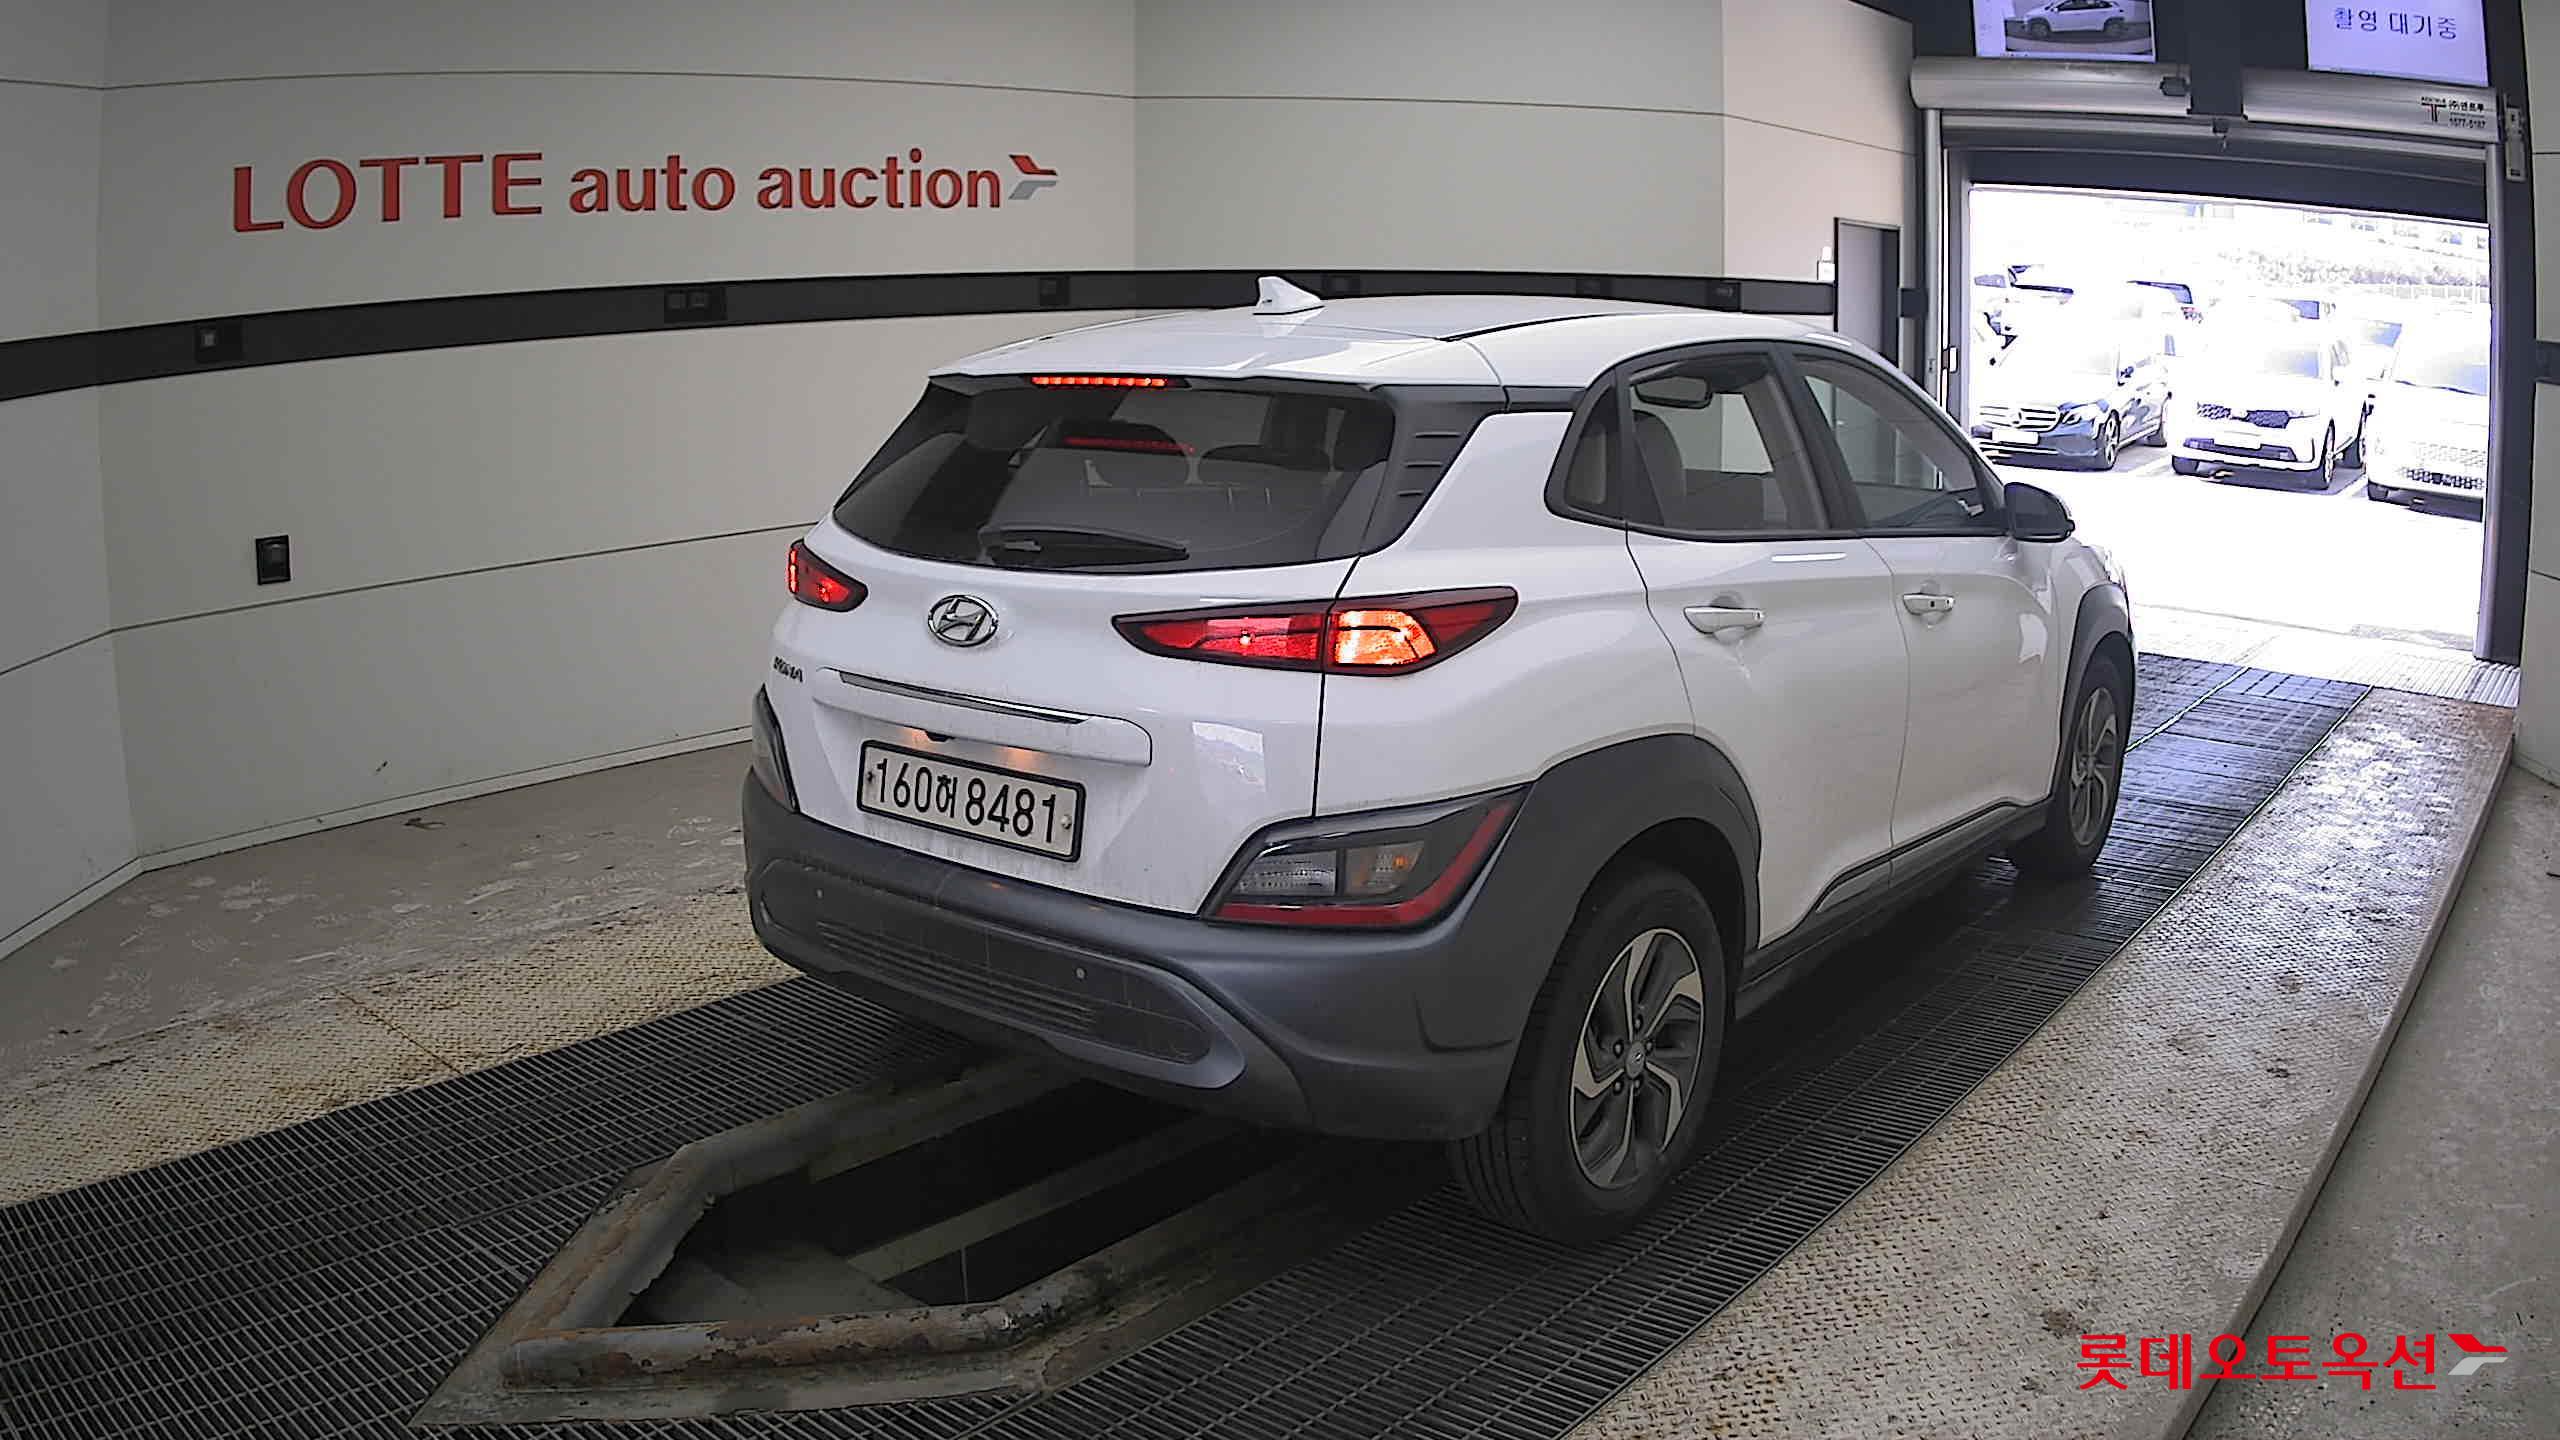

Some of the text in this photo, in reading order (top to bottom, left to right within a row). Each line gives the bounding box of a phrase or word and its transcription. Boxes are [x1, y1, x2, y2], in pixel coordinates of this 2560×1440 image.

[2389, 12, 2457, 40] 대기중
[234, 147, 1002, 232] LOTTE auto auction
